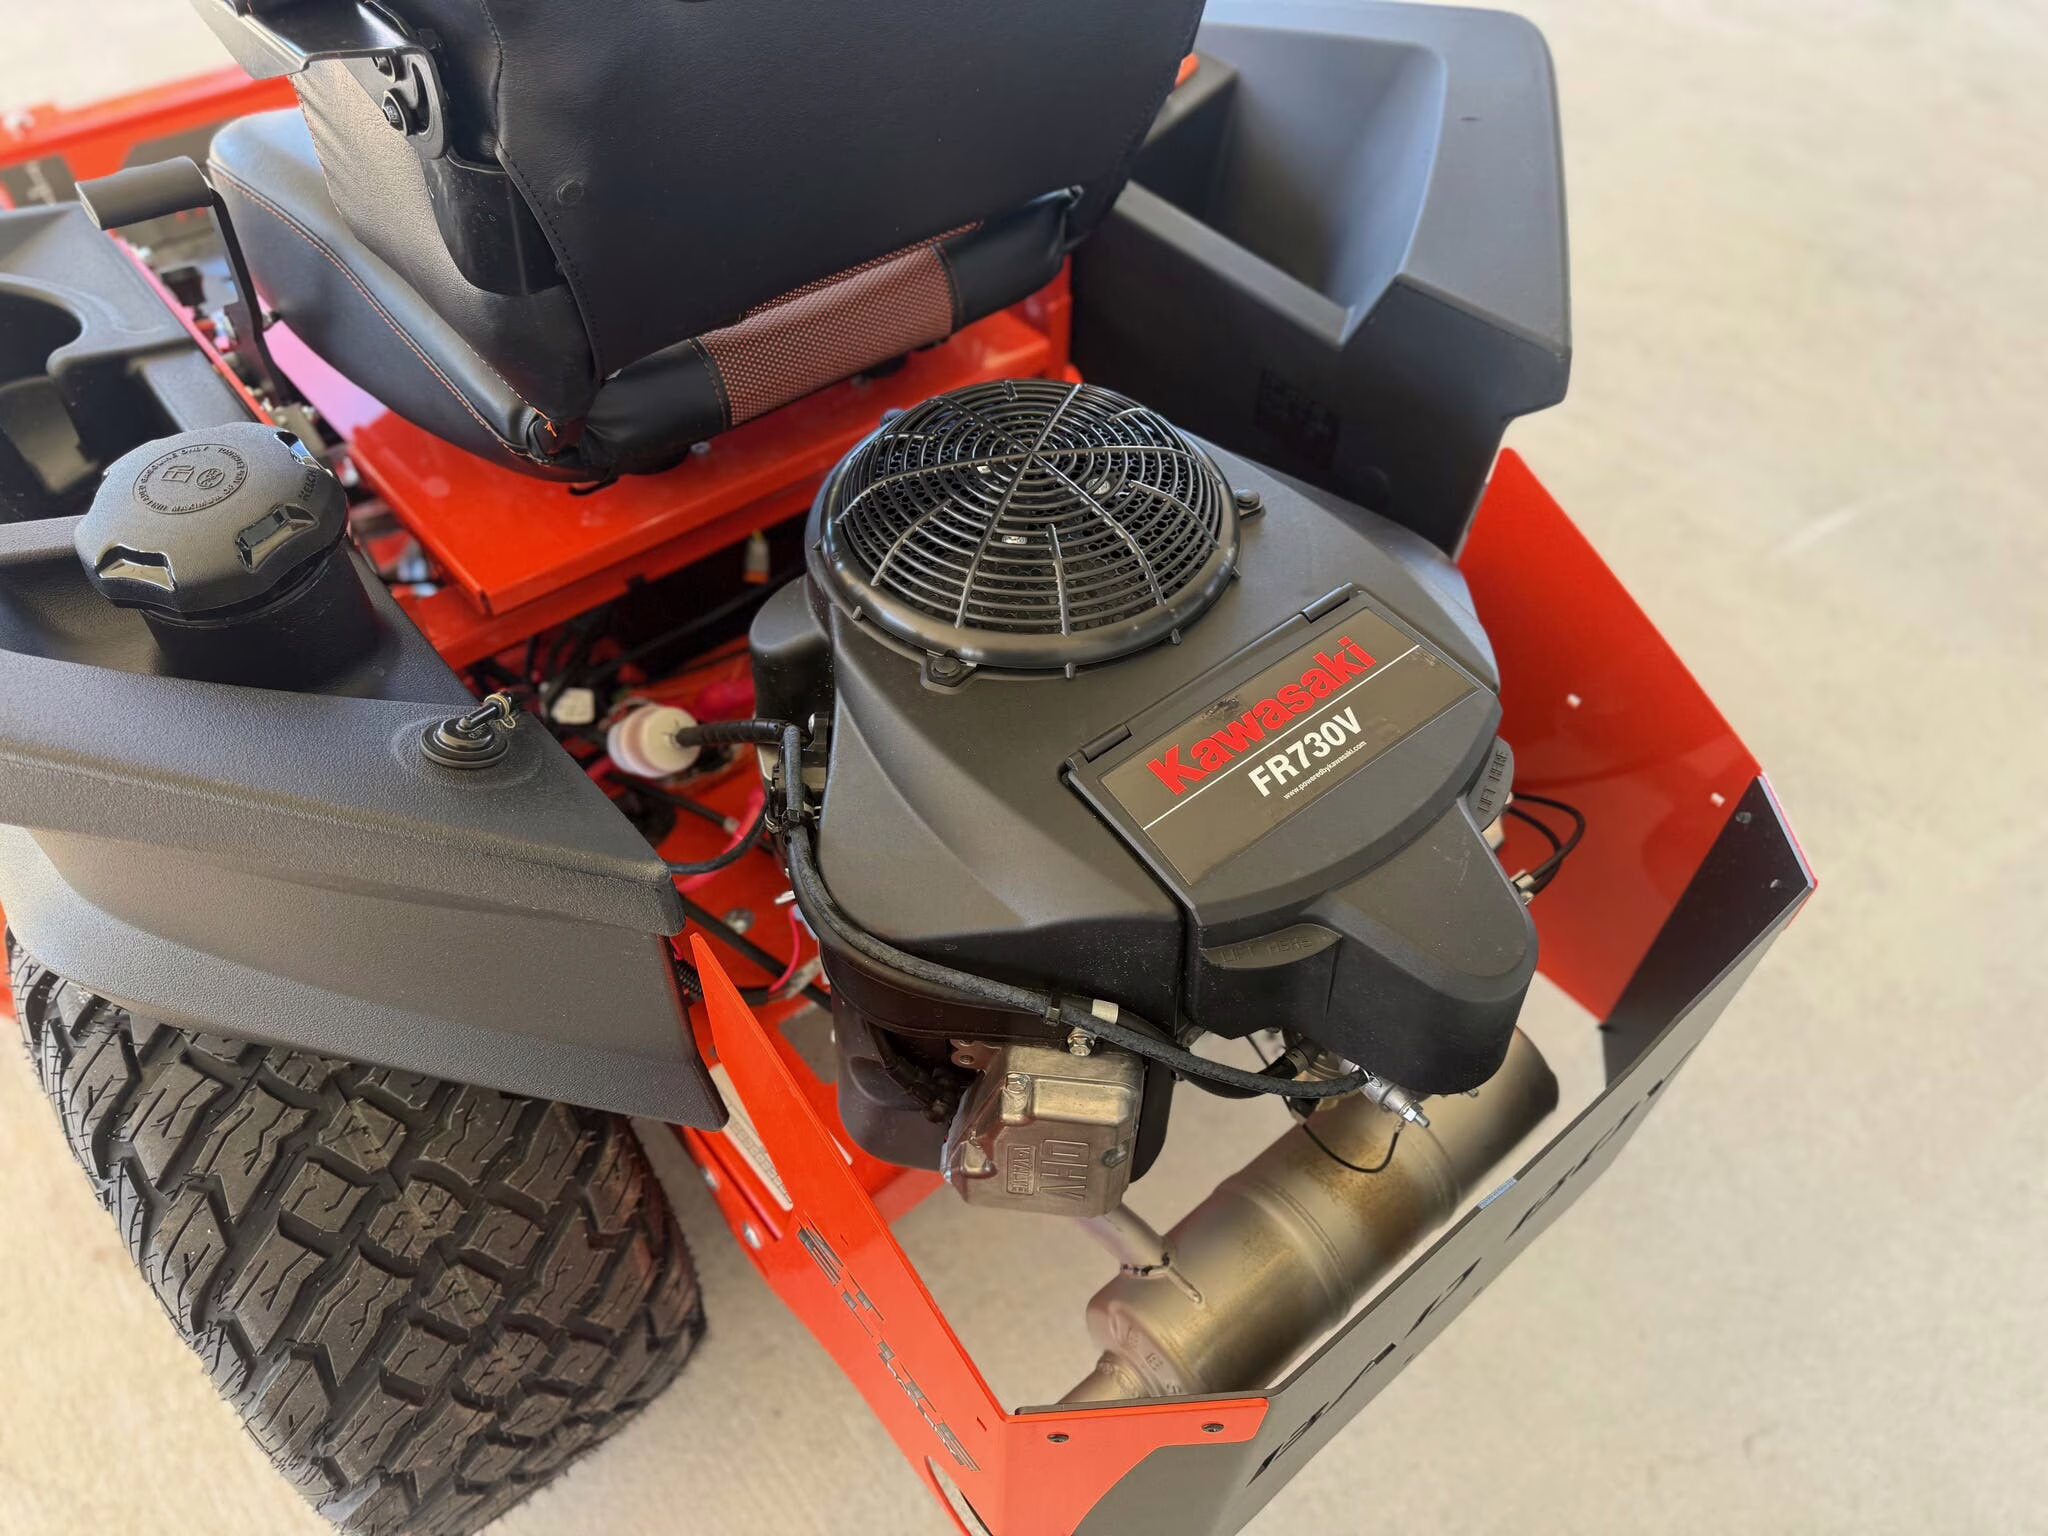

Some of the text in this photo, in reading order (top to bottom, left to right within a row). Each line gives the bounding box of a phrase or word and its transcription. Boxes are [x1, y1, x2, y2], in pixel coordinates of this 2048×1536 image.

[1146, 636, 1376, 796] Kawasaki
[1248, 706, 1362, 797] FR730V
[1283, 741, 1367, 799] www.poweredbykawasaki.com
[1477, 750, 1508, 815] LIFT HERE
[1220, 943, 1257, 962] LIFT
[1041, 1139, 1088, 1200] OHV
